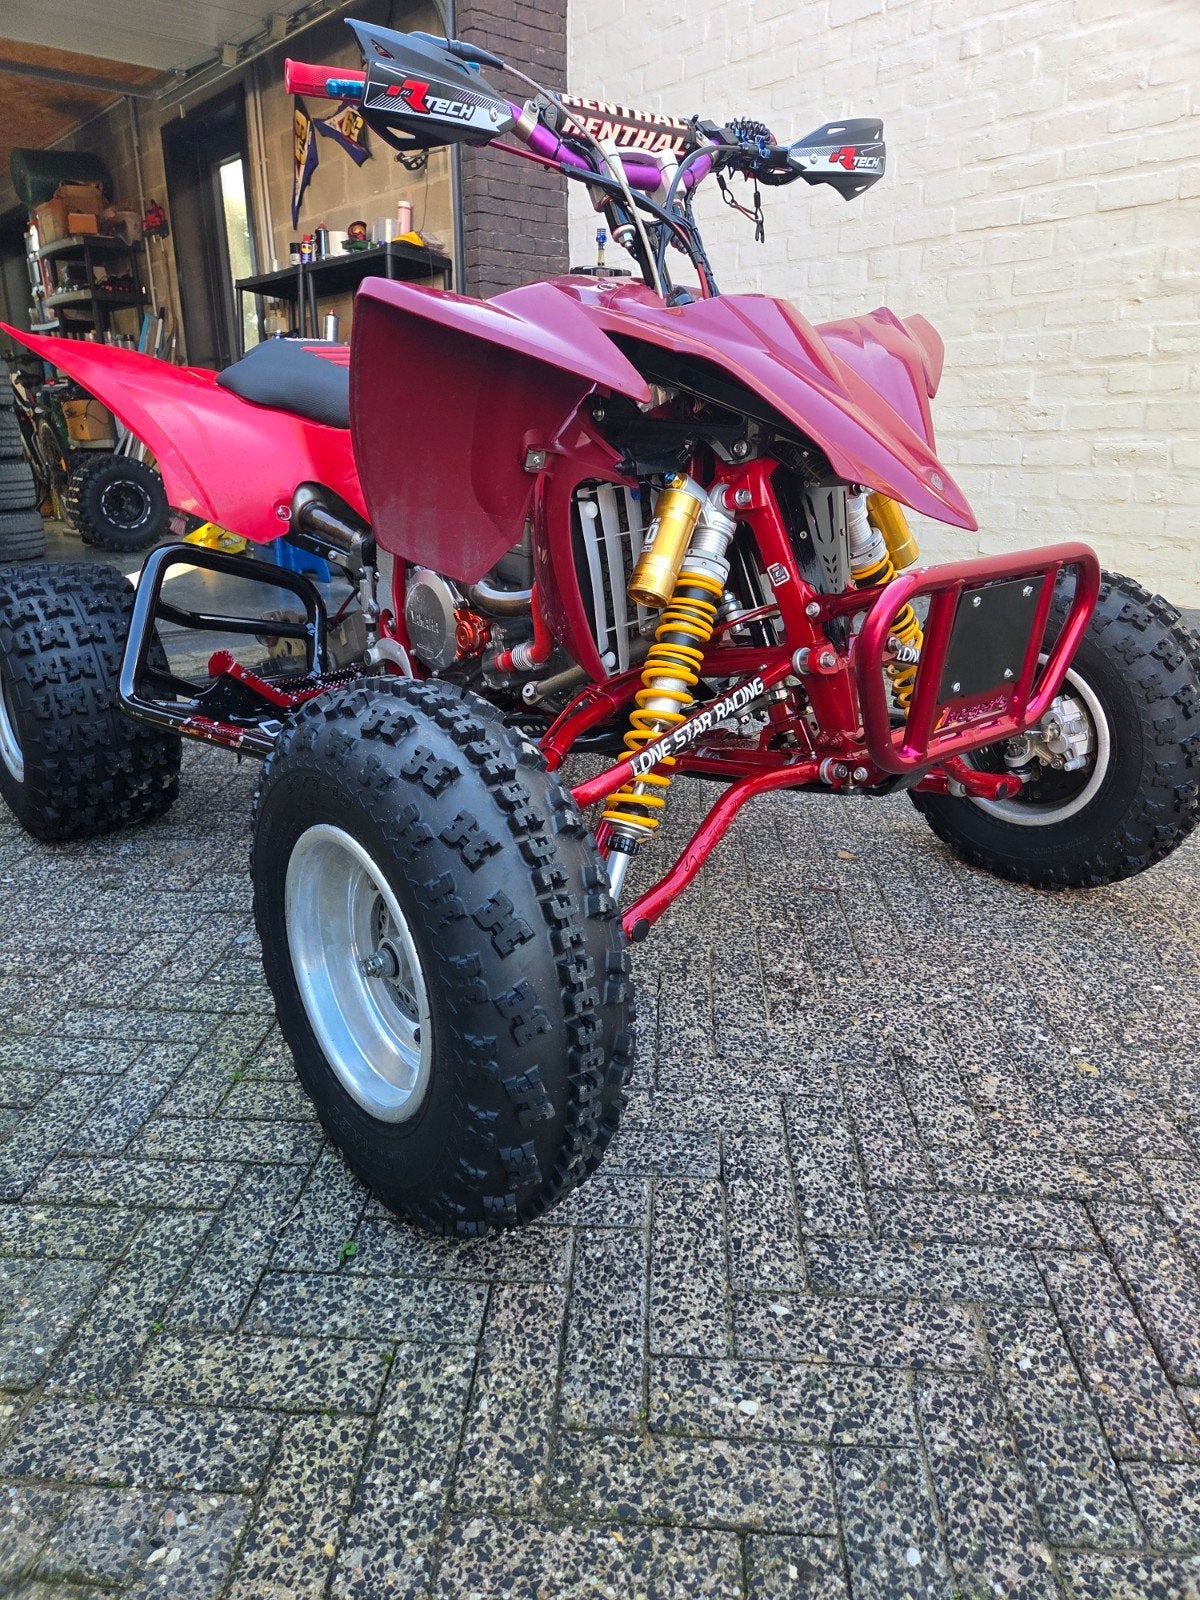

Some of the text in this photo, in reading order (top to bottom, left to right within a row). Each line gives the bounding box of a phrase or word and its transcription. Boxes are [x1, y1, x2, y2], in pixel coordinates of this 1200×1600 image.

[560, 93, 689, 131] RENTHAL
[561, 112, 687, 157] RENTHAL
[897, 647, 920, 663] LON
[629, 677, 764, 777] LONE STAR RACING
